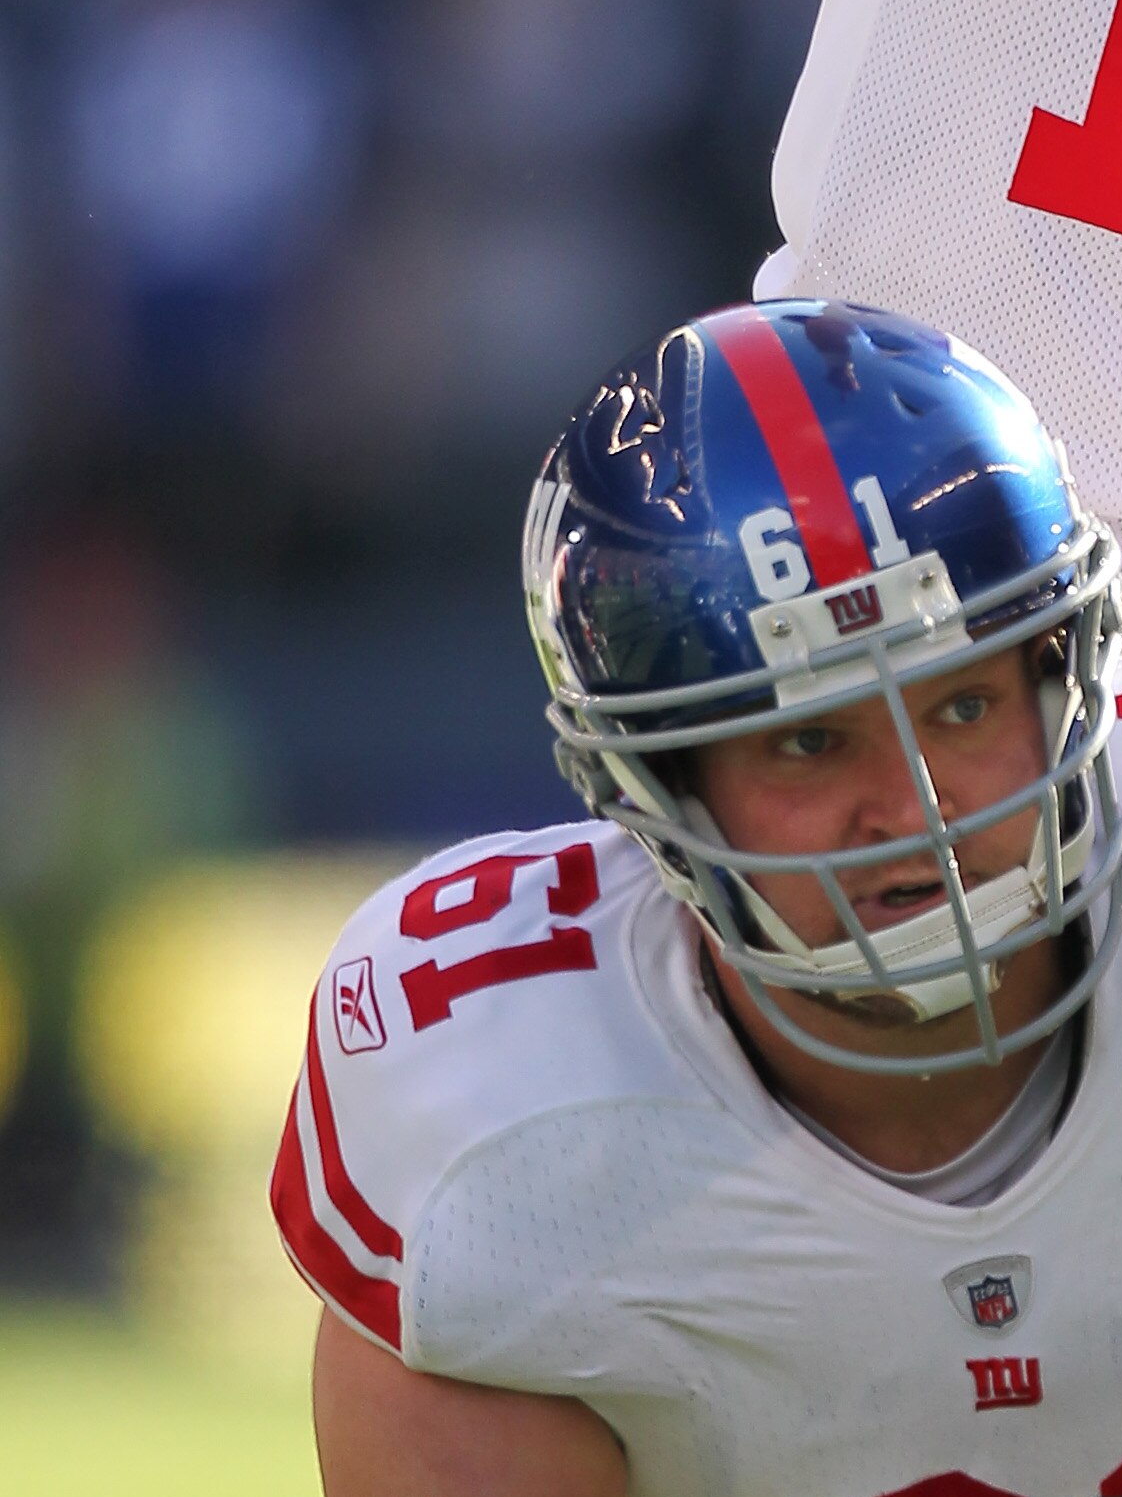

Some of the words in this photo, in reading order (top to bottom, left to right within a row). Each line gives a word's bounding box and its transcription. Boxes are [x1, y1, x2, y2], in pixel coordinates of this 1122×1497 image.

[739, 475, 912, 602] 61
[400, 842, 600, 1033] 61
[975, 1294, 1014, 1321] NFL
